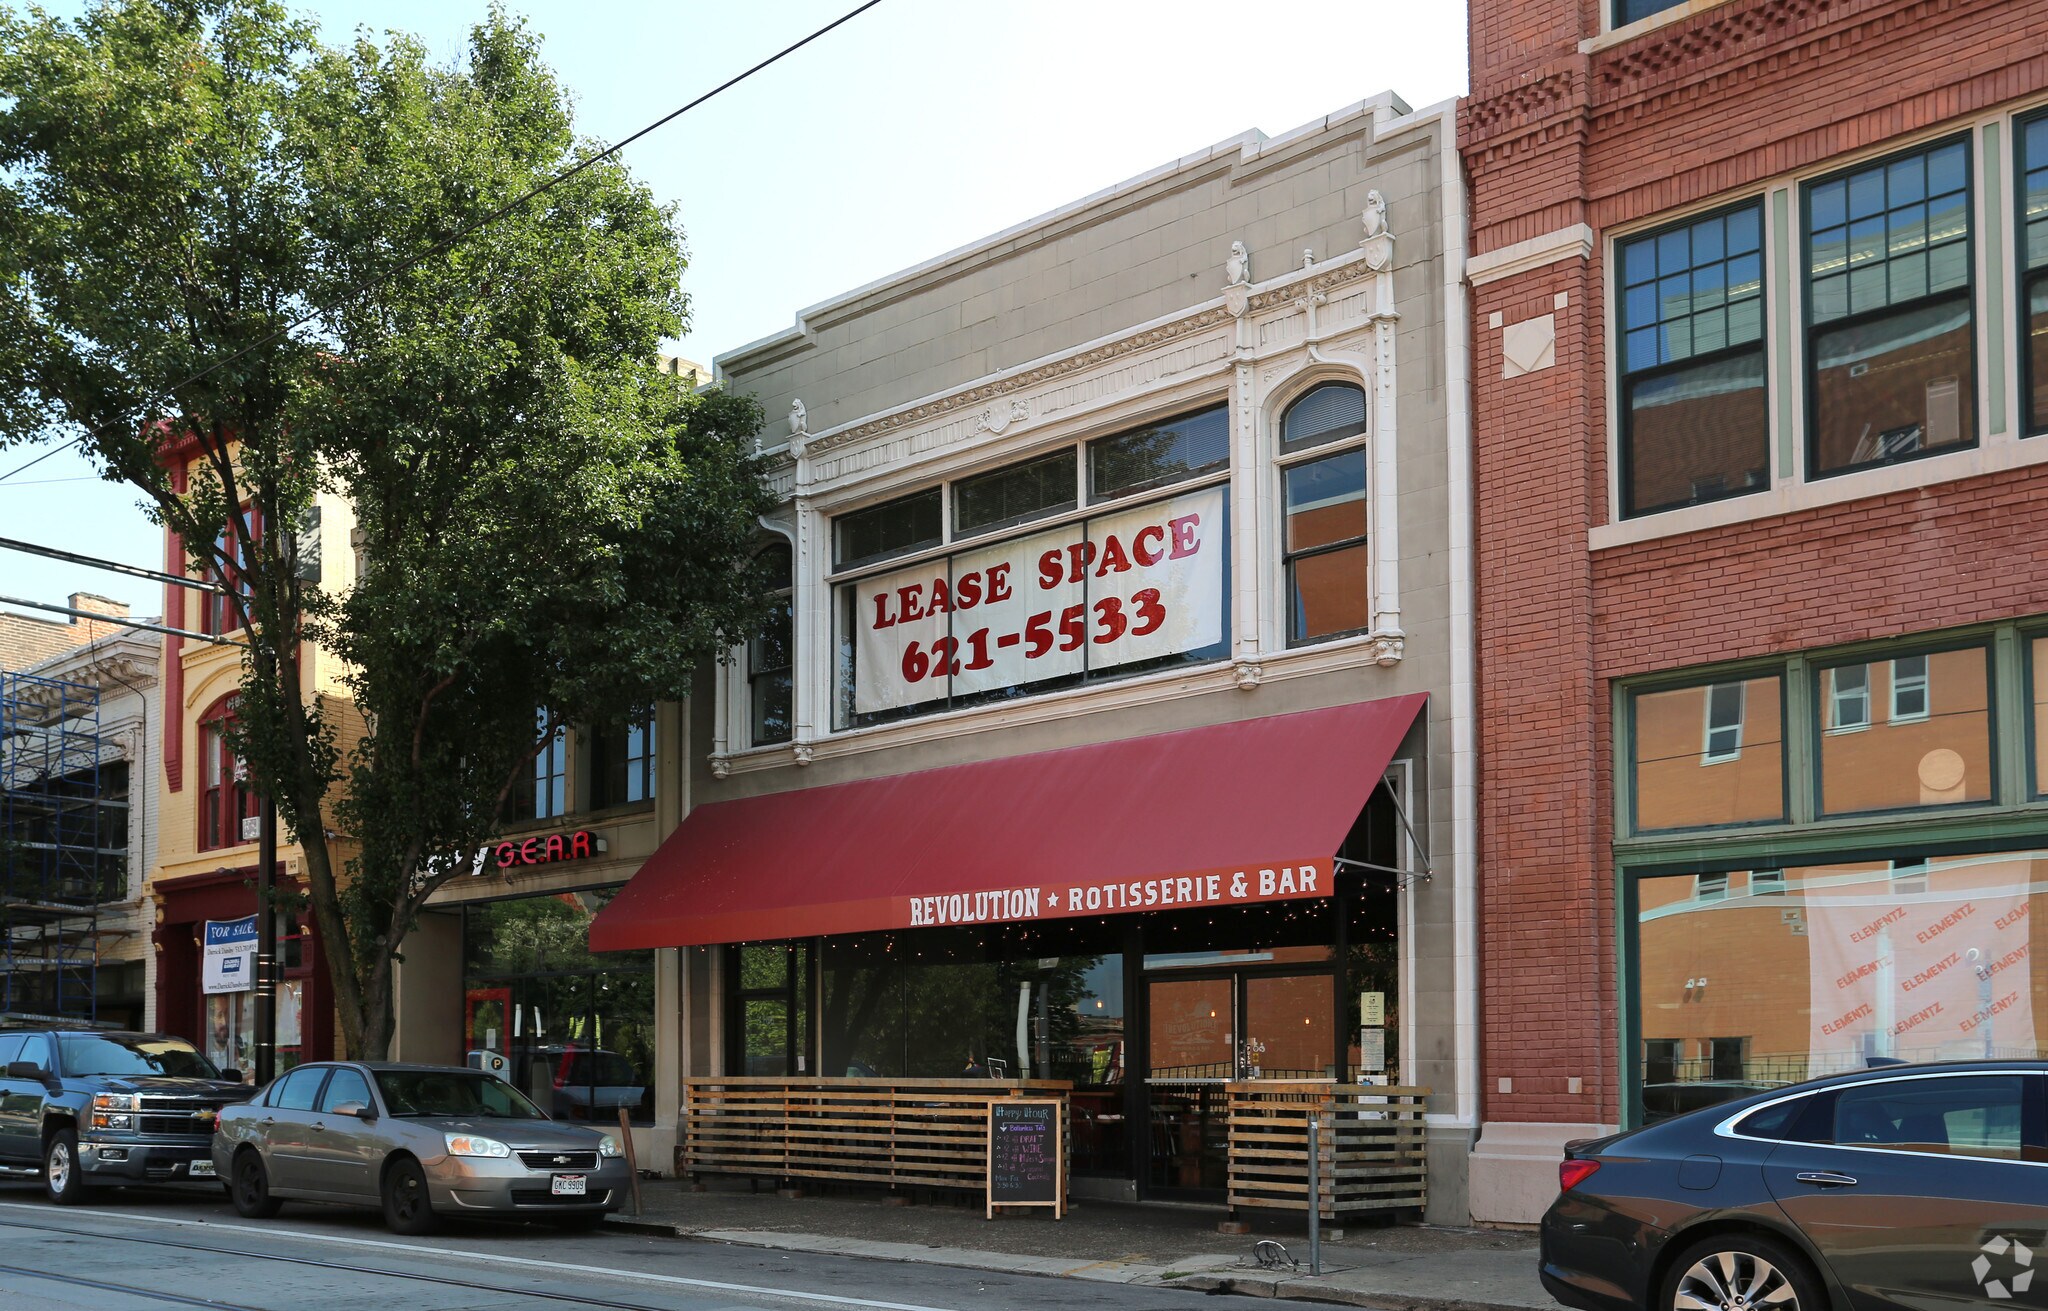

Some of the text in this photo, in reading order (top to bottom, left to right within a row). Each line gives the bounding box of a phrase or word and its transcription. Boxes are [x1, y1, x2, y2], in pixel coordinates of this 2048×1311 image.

[872, 512, 1201, 630] LEASE SPACE
[902, 588, 1167, 684] 621-5533
[910, 865, 1317, 926] REVOLUTION ROTISSERIE & BAR
[211, 922, 254, 938] FOR SALE
[1849, 906, 1908, 943] ELEMENTZ
[1915, 902, 1976, 944] ELEMENTZ
[1836, 955, 1893, 990] ELEMENTZ
[1901, 952, 1961, 992] ELEMENTZ
[1821, 1003, 1873, 1036] ELEMENTZ
[1887, 1001, 1944, 1038] ELEMENTZ
[1959, 991, 2019, 1033] ELEMENTZ
[493, 1059, 501, 1069] P
[568, 1180, 584, 1190] 9909
